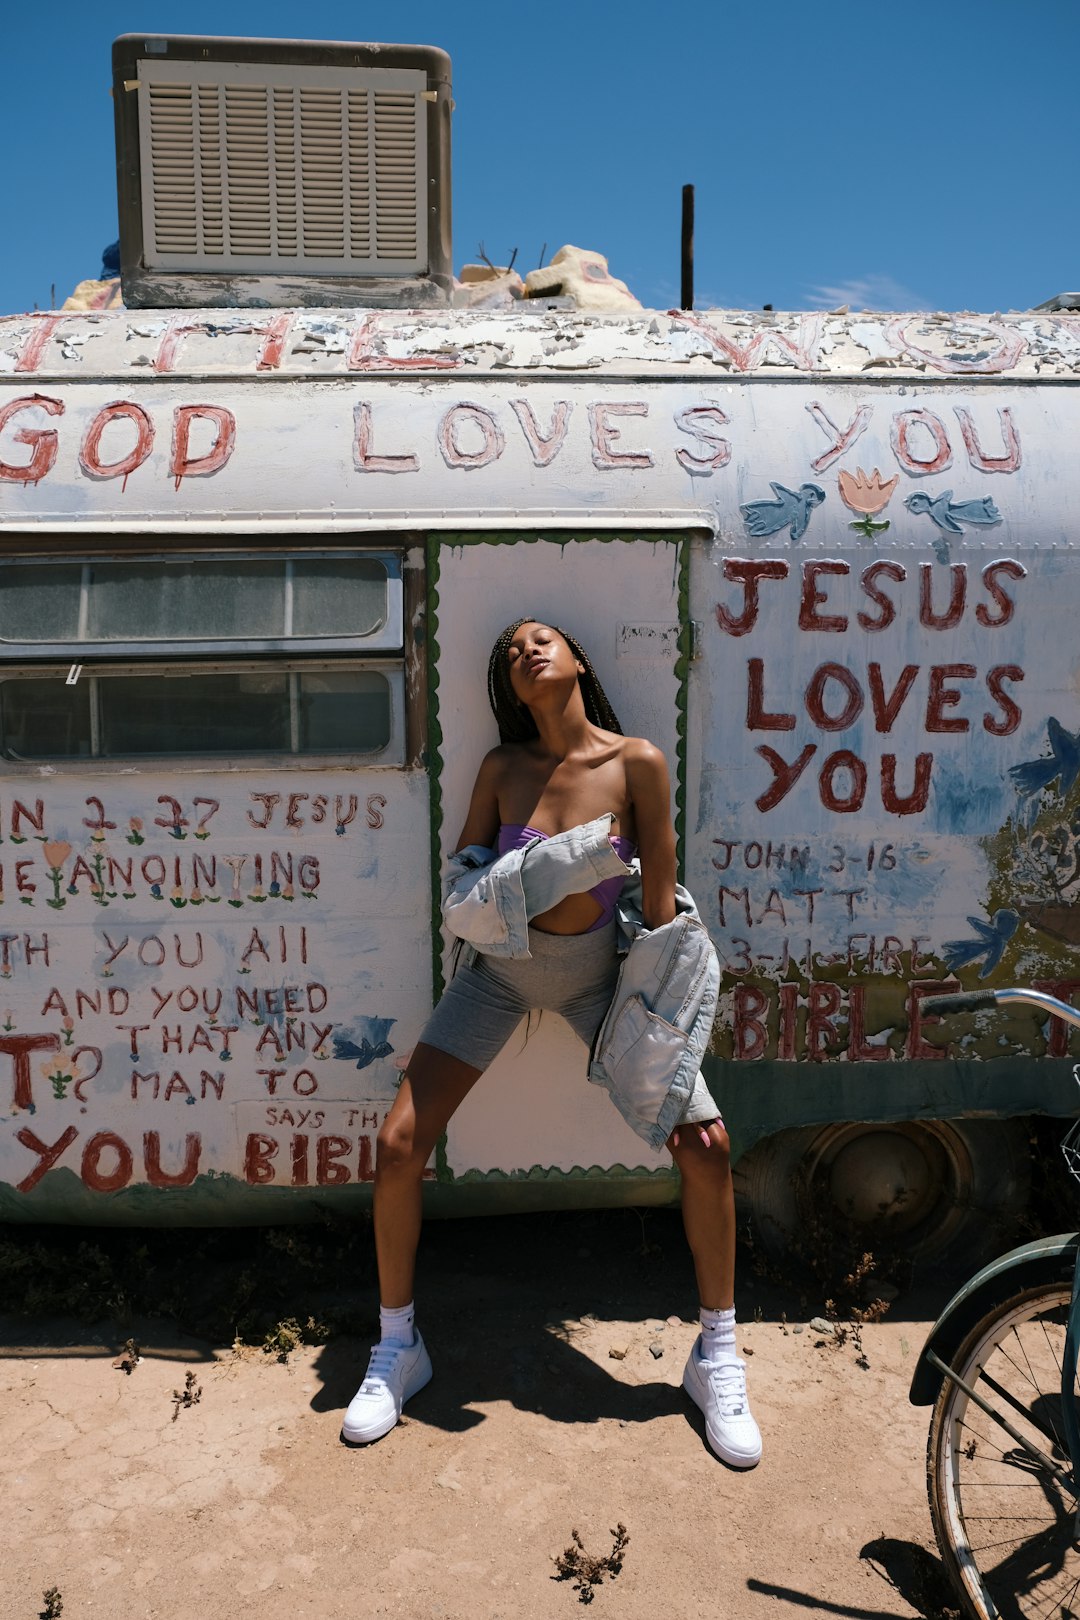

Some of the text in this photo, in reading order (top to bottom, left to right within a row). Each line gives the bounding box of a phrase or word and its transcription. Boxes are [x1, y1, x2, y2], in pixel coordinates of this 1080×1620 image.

[0, 393, 1021, 482] GOD LOVES YOU
[715, 557, 1027, 637] JESUS
[746, 658, 1025, 736] LOVES
[754, 744, 933, 817] YOU
[246, 792, 387, 829] JESUS
[0, 852, 321, 893] E ANOINTING
[828, 844, 897, 872] 3-16
[718, 885, 864, 928] MATT
[102, 932, 203, 968] YOU
[41, 982, 328, 1019] AND YOU NEED
[115, 1022, 334, 1056] THAT ANY
[130, 1068, 319, 1100] MAN TO
[266, 1107, 390, 1129] SAYS TH
[14, 1125, 203, 1193] YOU
[243, 1132, 437, 1186] BIBL
